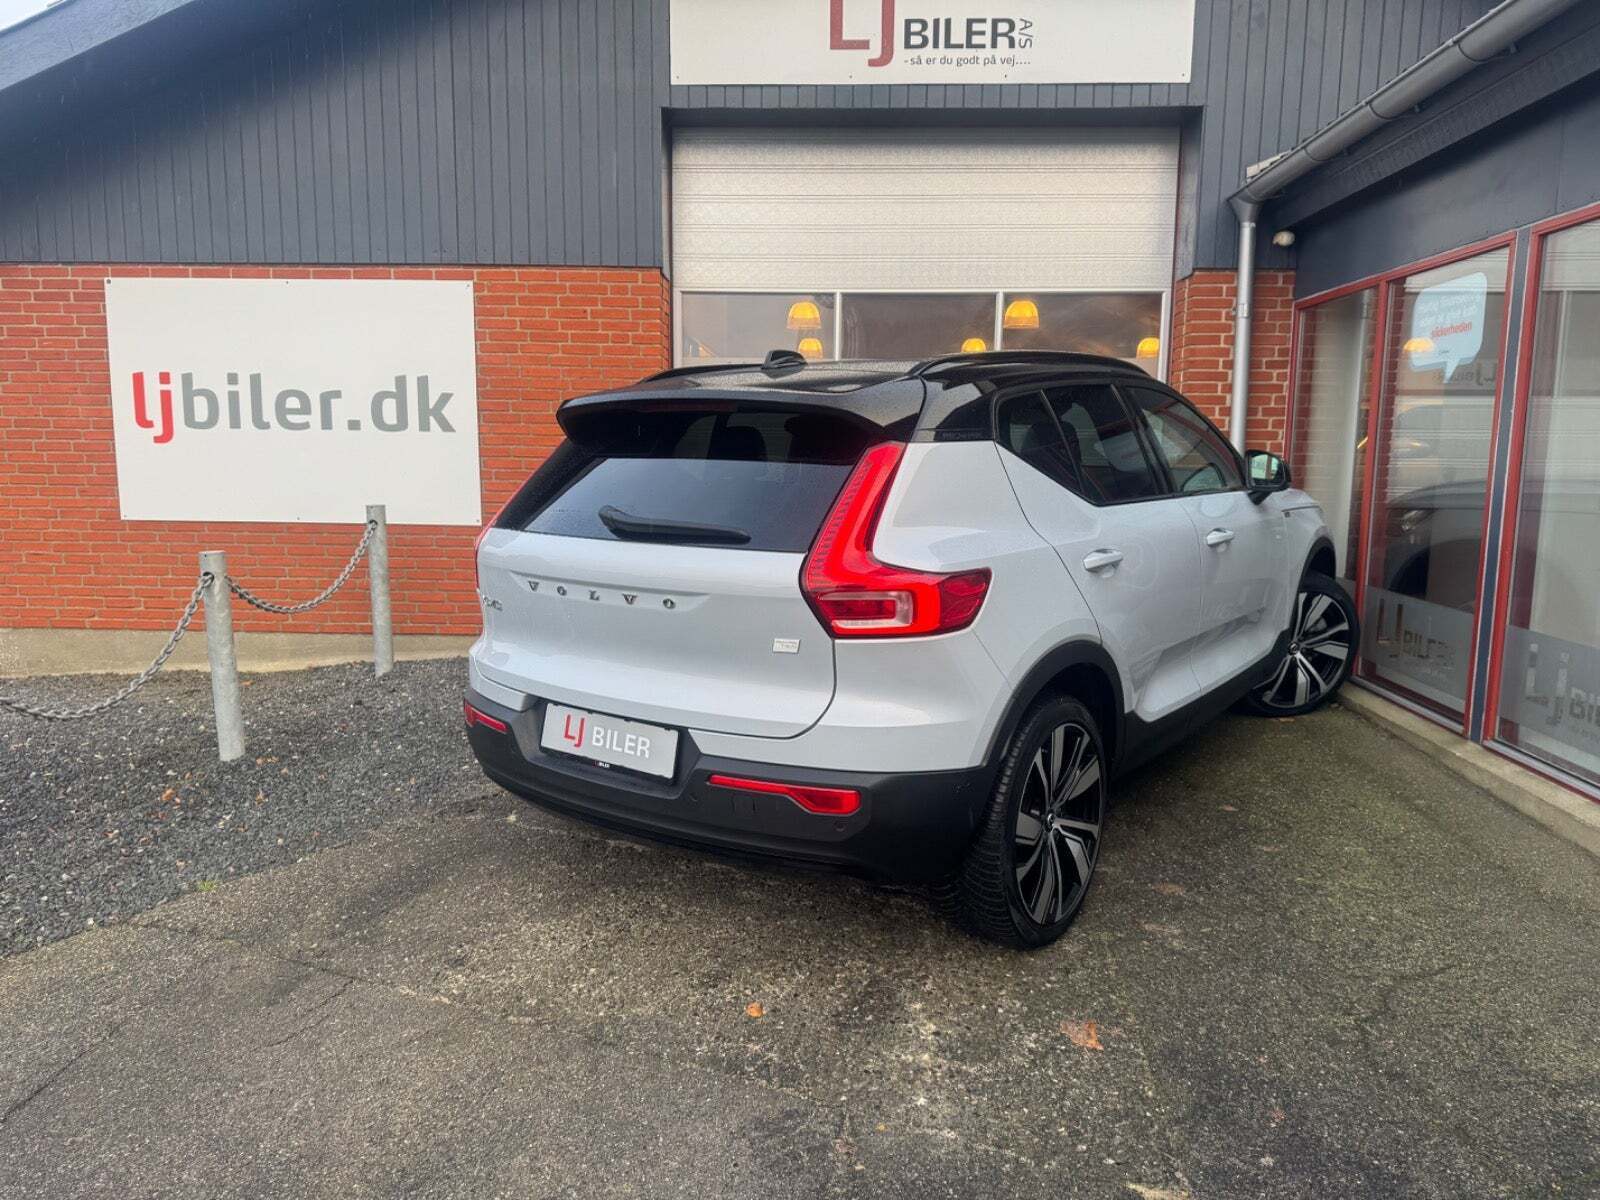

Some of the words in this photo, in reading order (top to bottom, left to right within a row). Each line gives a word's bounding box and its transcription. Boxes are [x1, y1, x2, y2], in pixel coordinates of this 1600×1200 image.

[830, 0, 895, 67] LJ
[904, 18, 1016, 49] BILER
[1018, 18, 1034, 49] A/S
[926, 56, 936, 65] er
[940, 55, 953, 65] du
[956, 55, 979, 67] godt
[983, 54, 997, 67] på
[132, 372, 456, 443] ljbiler.dk
[528, 580, 676, 609] VOLVO
[563, 713, 586, 748] LJ
[592, 726, 651, 759] BILER
